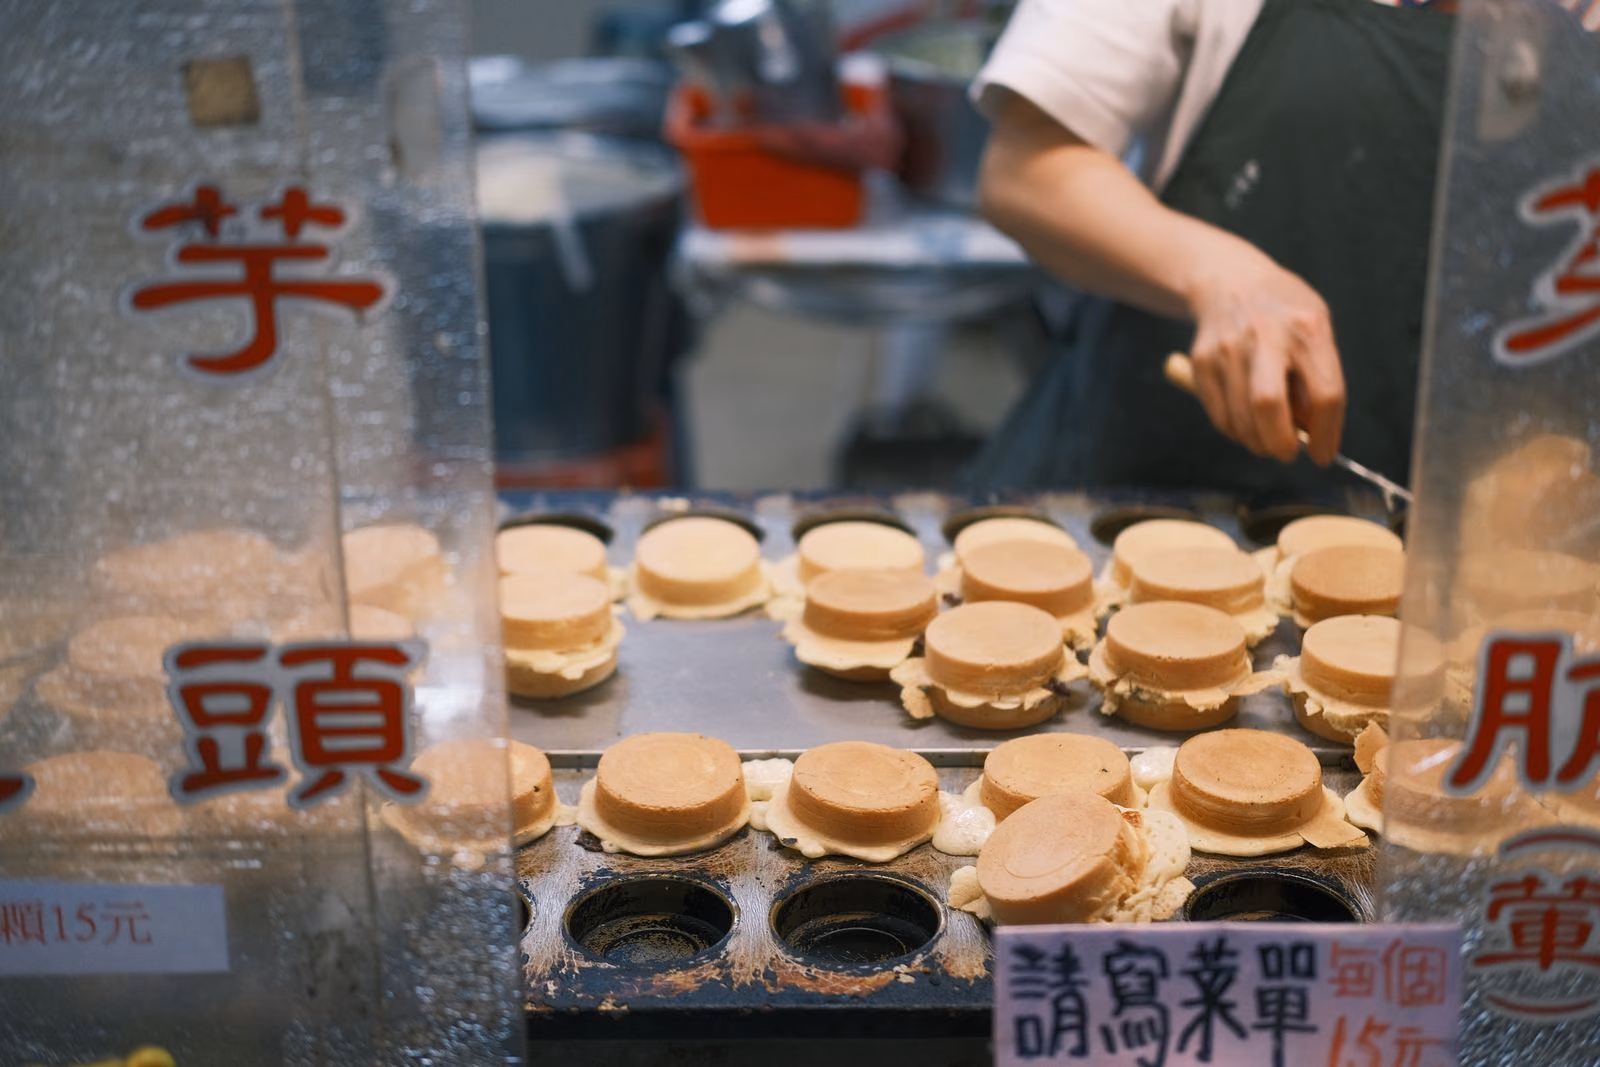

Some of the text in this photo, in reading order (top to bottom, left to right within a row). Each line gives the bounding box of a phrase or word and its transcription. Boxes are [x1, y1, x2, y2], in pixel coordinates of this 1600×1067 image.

[131, 185, 424, 802] 芋頭
[1009, 936, 1318, 1067] 請寫菜單
[1328, 938, 1447, 1007] 每個
